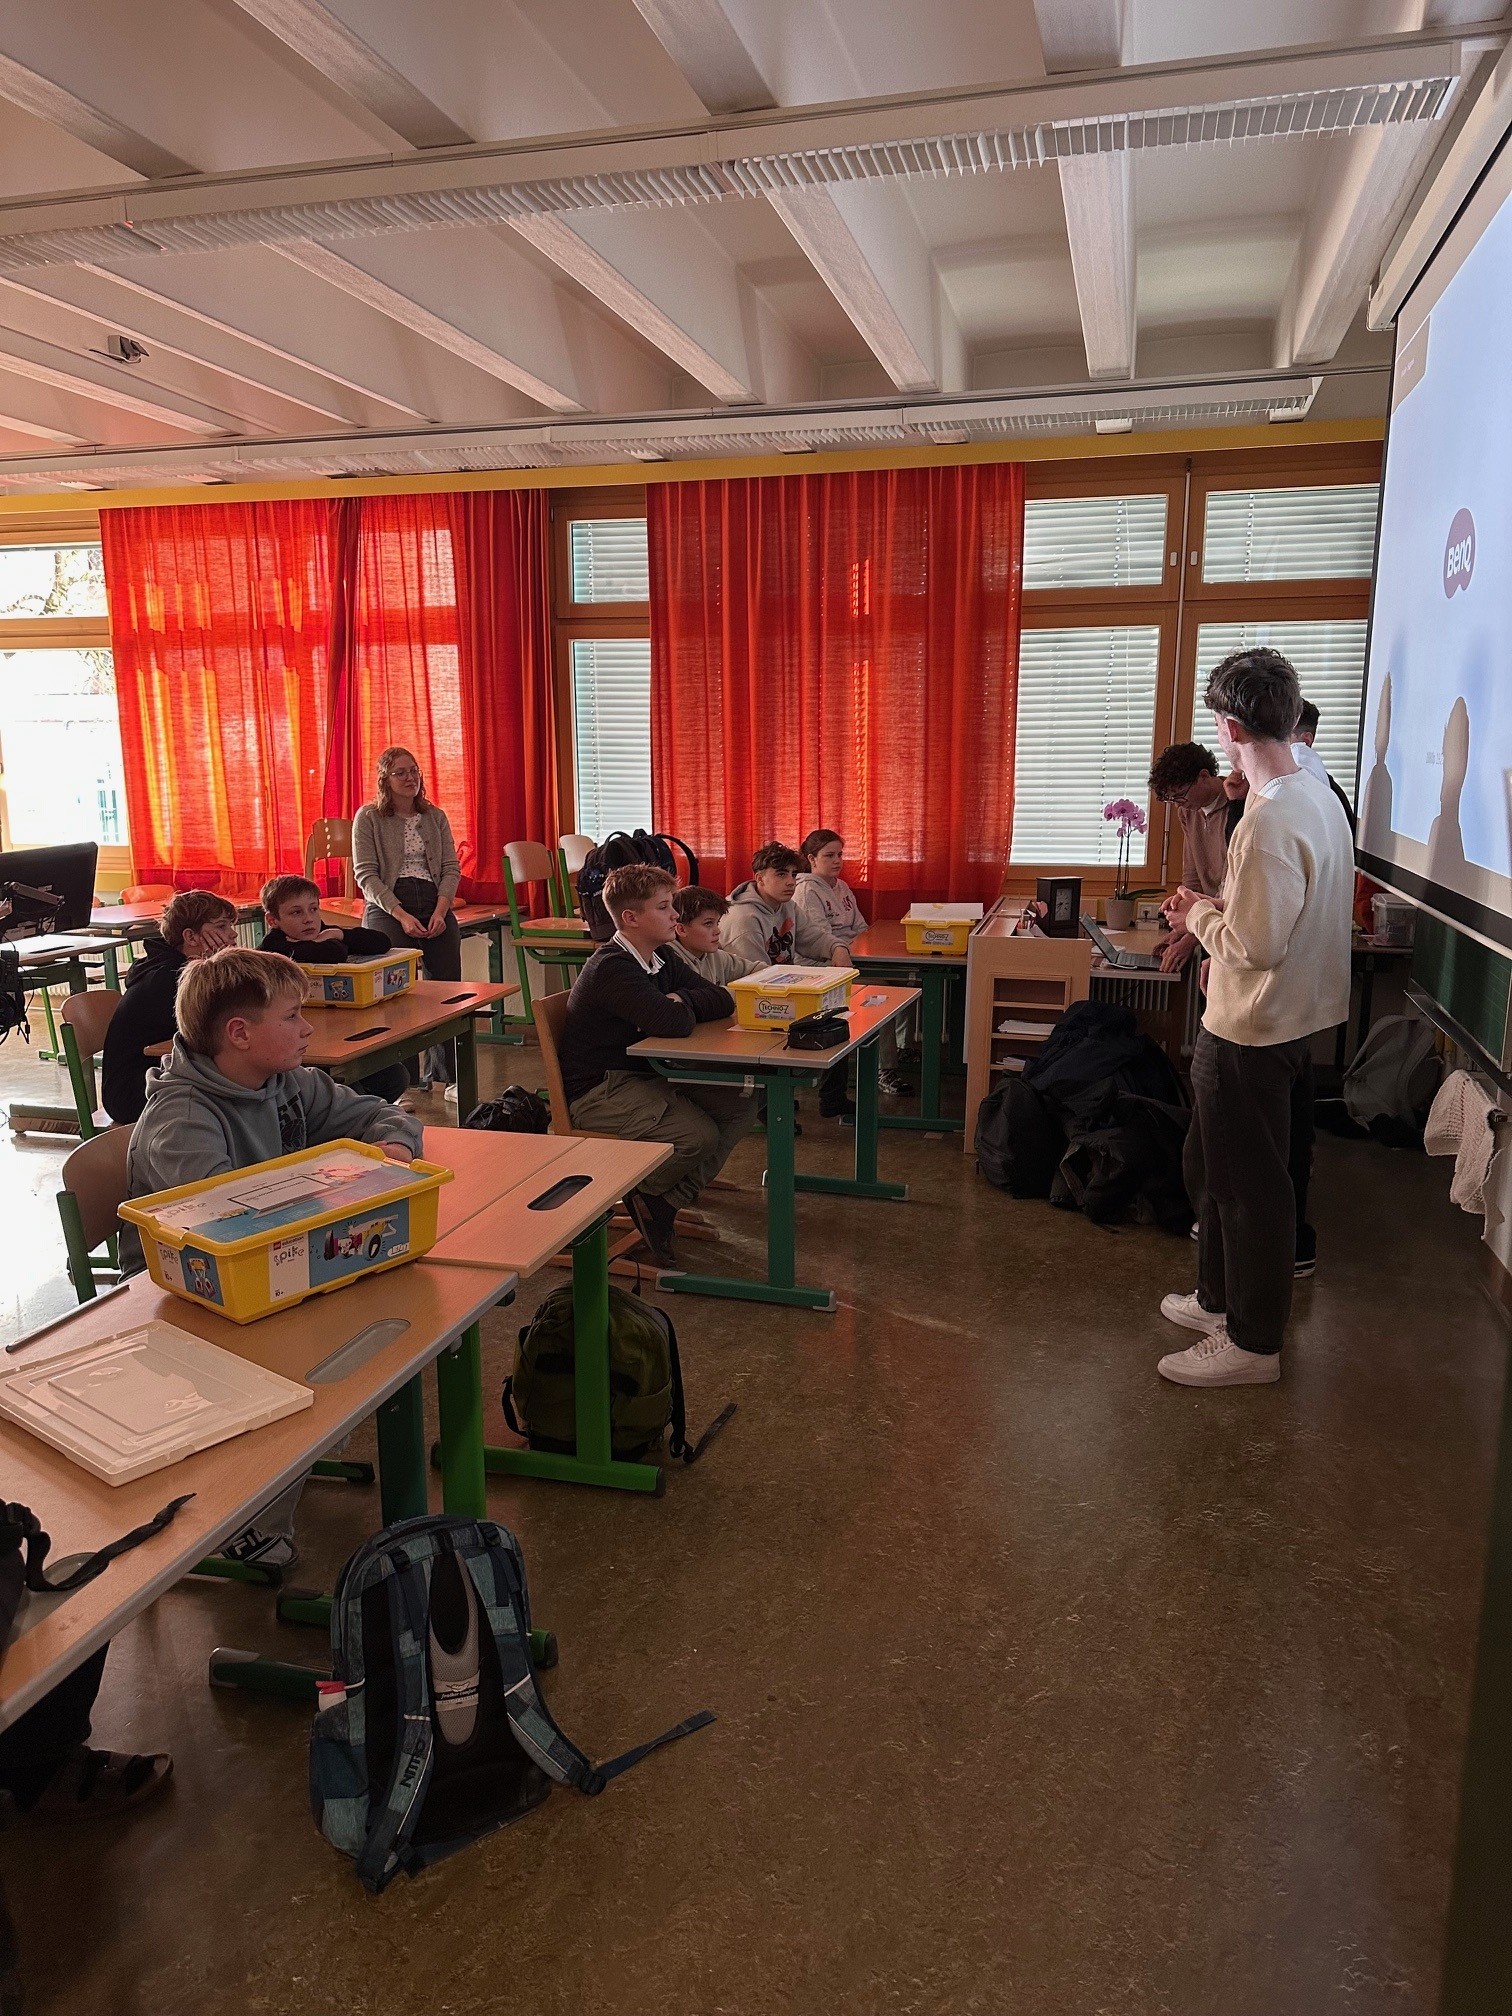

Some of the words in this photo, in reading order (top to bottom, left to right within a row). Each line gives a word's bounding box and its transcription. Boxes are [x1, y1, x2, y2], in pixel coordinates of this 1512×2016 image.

[1446, 535, 1472, 579] BenQ
[273, 1245, 305, 1267] spike
[232, 1530, 269, 1556] FIL
